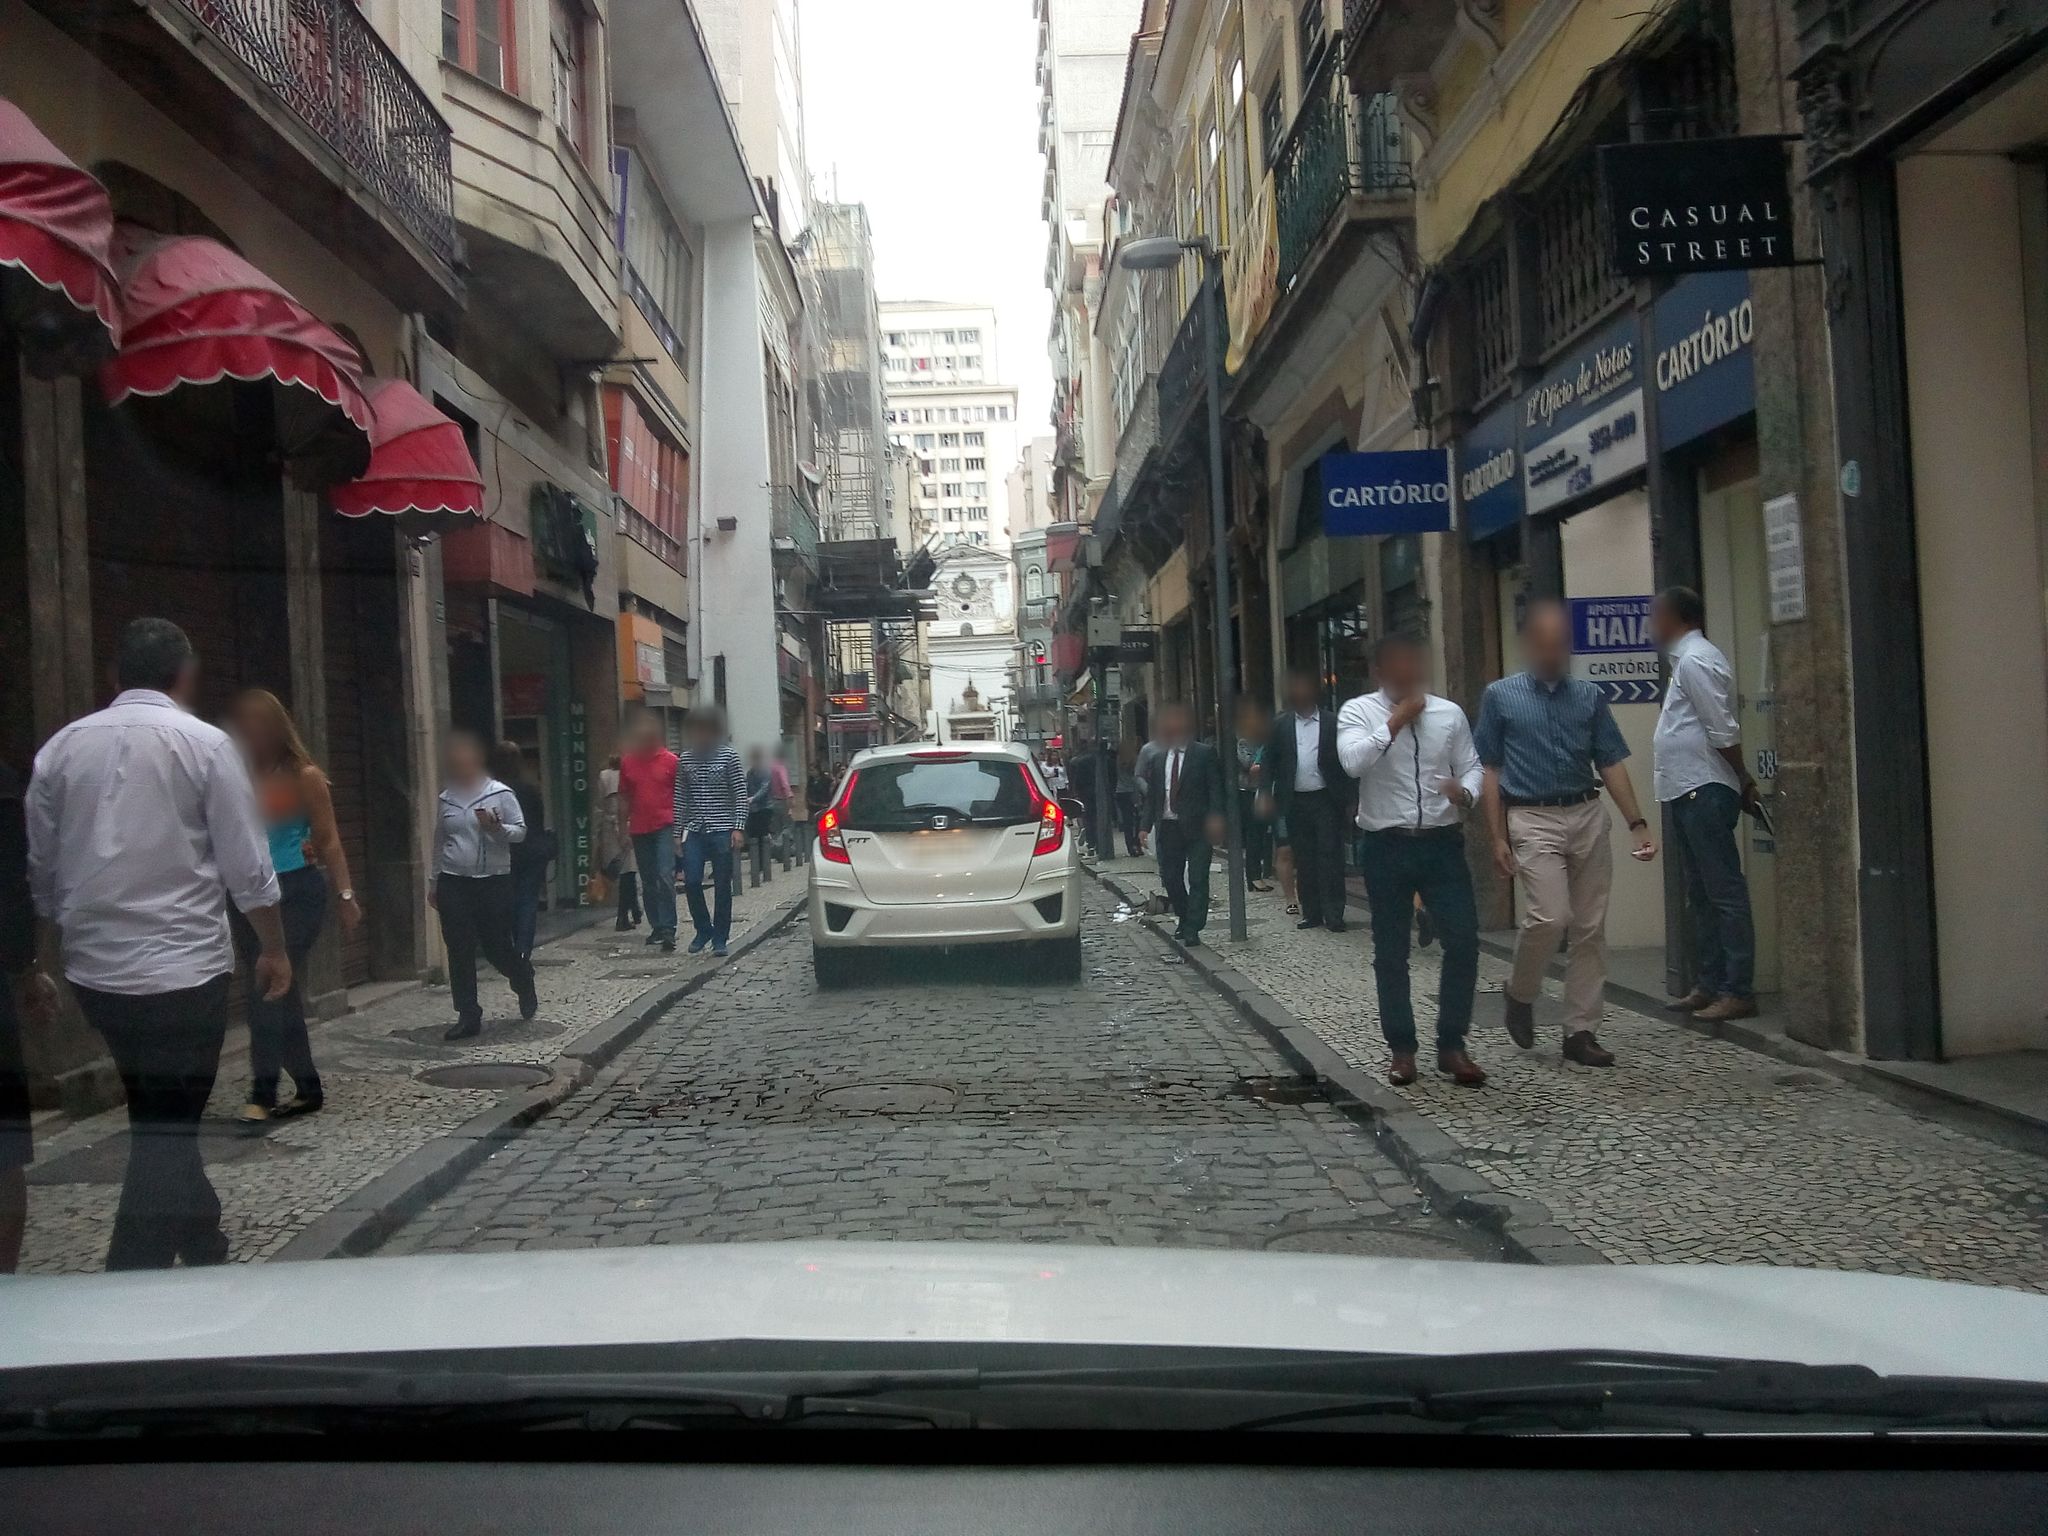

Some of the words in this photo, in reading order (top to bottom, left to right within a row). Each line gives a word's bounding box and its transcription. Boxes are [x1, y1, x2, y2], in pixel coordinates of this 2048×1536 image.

[1630, 202, 1777, 229] CASUAL
[1638, 236, 1776, 264] STREET
[1656, 298, 1753, 391] CARTÓRIO
[1576, 361, 1592, 396] de
[1594, 342, 1633, 385] Notas
[1328, 479, 1449, 508] CARTÓRIO
[570, 703, 588, 792] MUNDO
[1757, 750, 1777, 779] 38
[575, 816, 591, 905] VERDE
